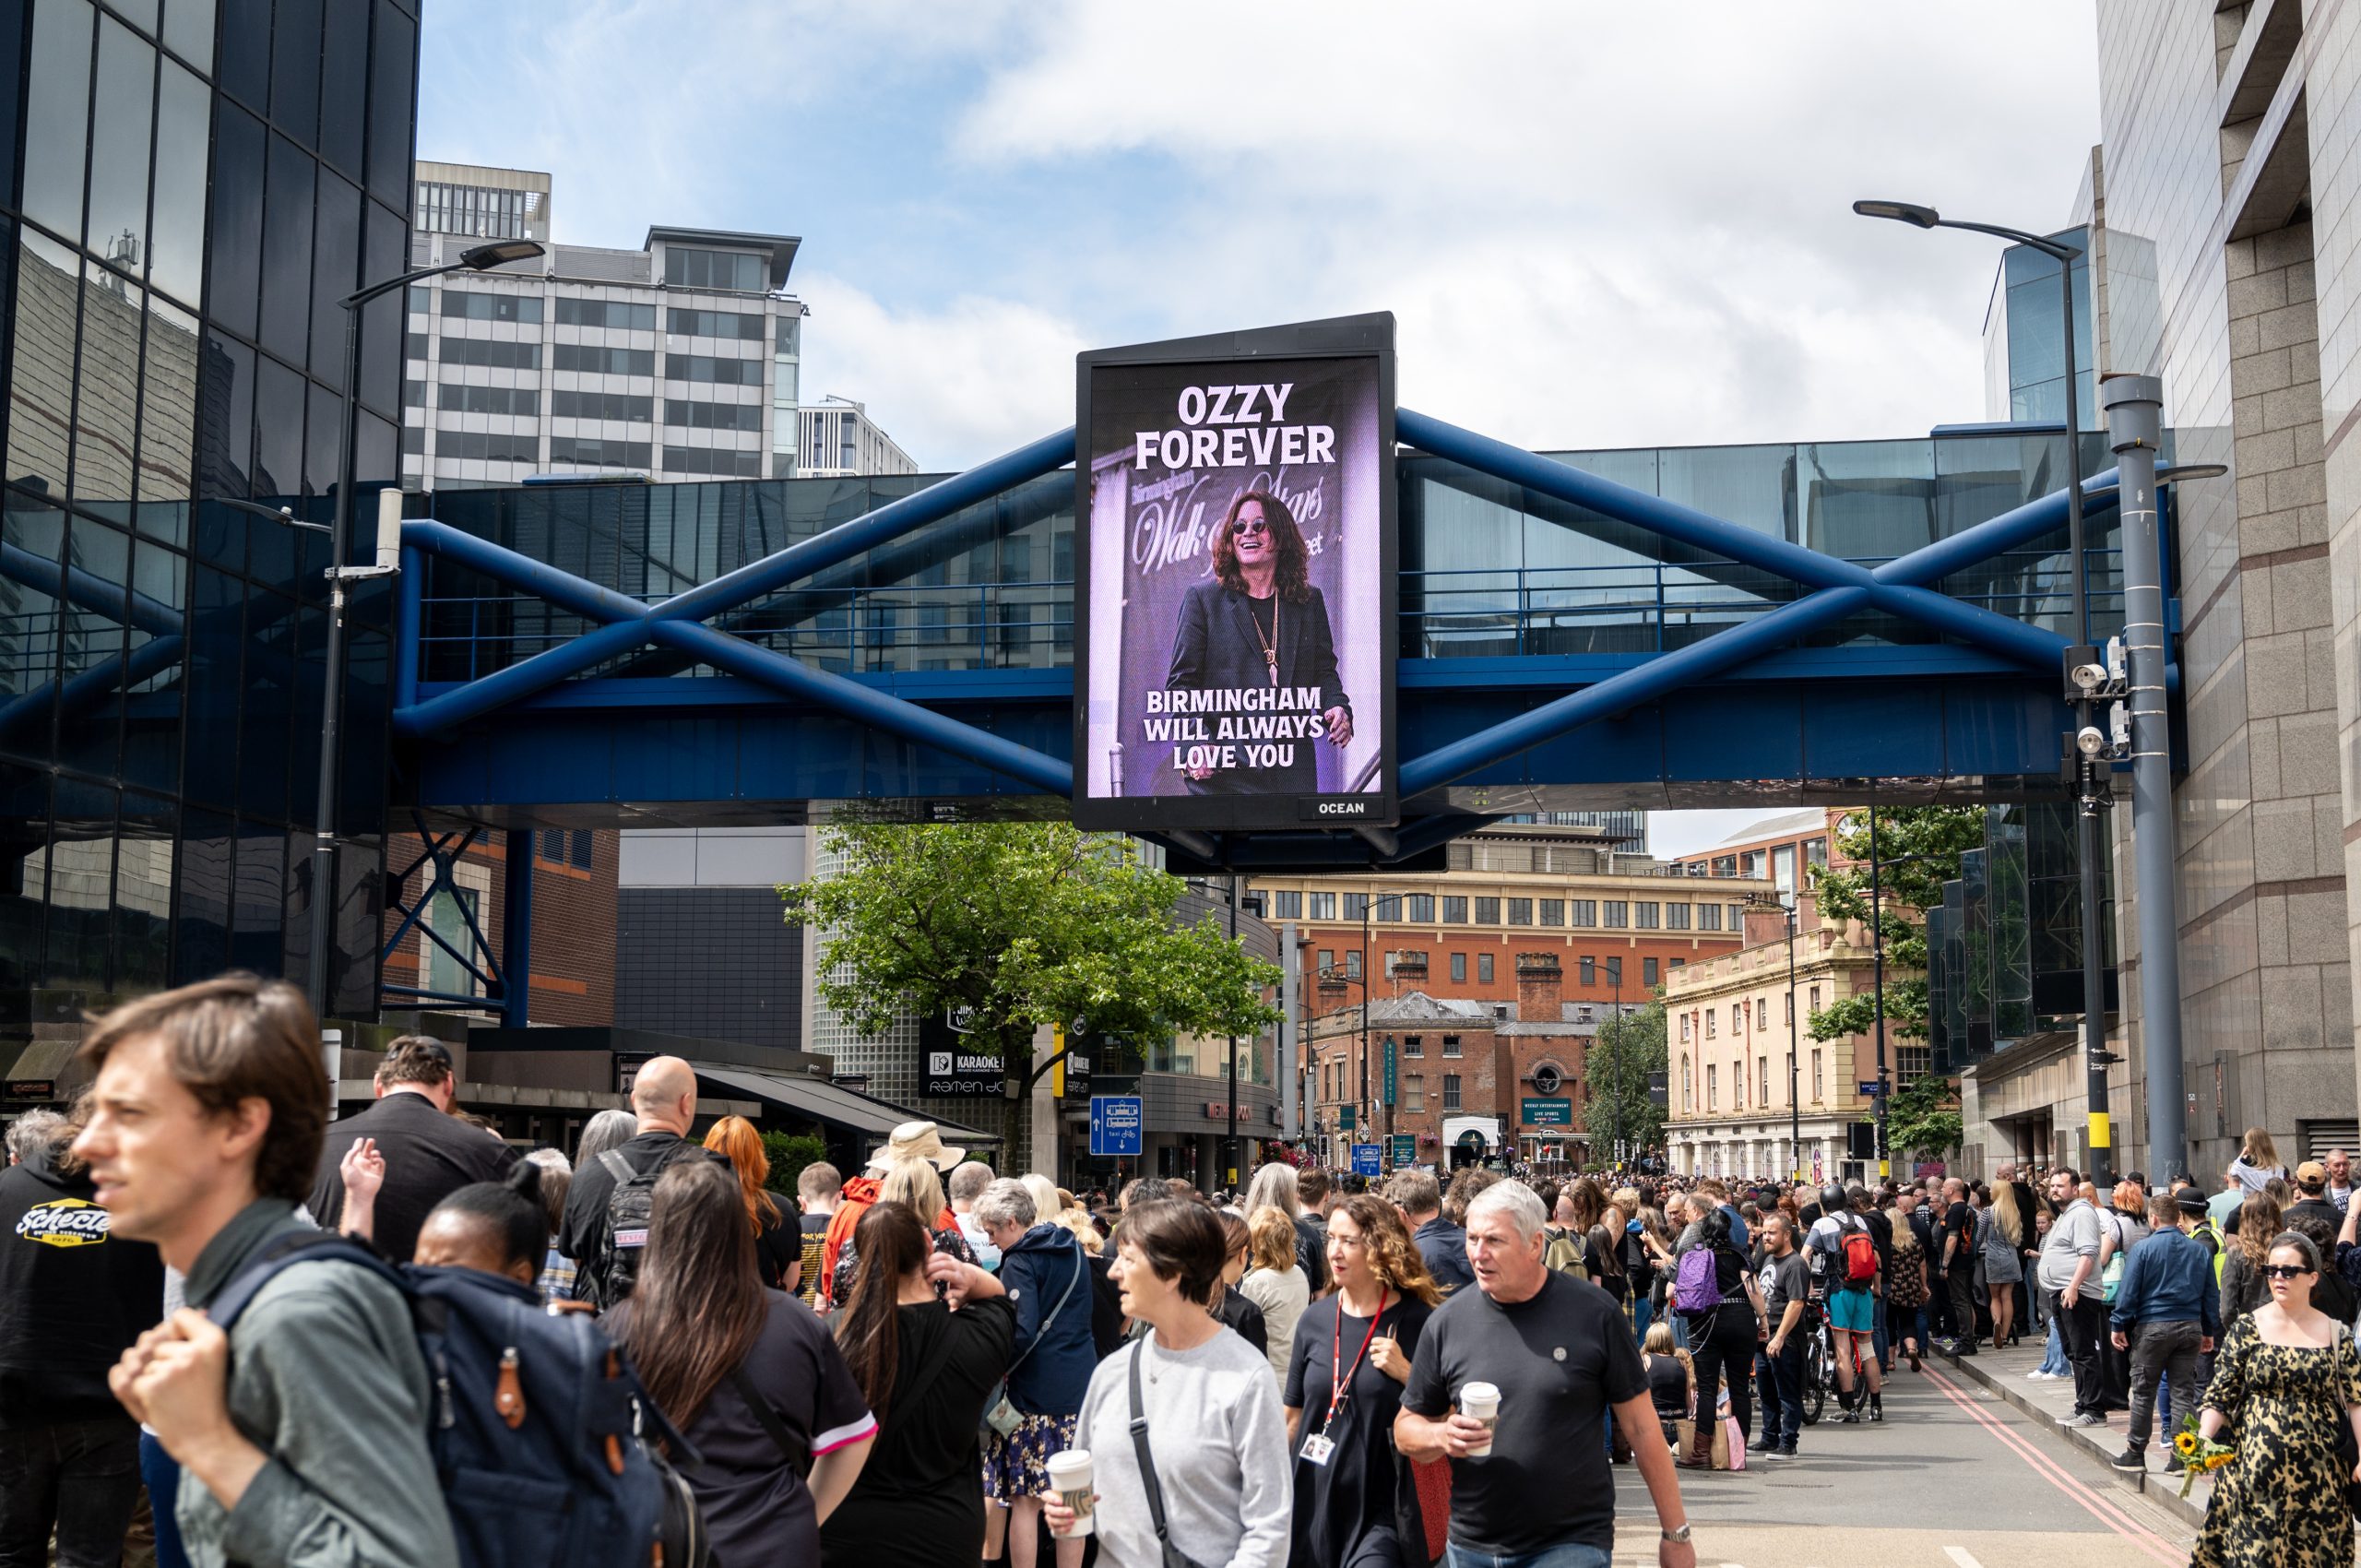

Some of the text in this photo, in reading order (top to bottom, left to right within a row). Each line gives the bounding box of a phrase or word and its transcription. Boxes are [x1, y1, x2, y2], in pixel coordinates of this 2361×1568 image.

[1178, 383, 1294, 425] OZZY
[1135, 425, 1335, 470] FOREVER
[1146, 686, 1322, 713] BIRMINGHAM
[1144, 715, 1323, 742] WILL ALWAYS
[1173, 743, 1294, 769] LOVE YOU
[1318, 802, 1365, 814] OCEAN
[957, 1056, 1000, 1068] KARAOKE
[16, 1206, 113, 1234] Schecte
